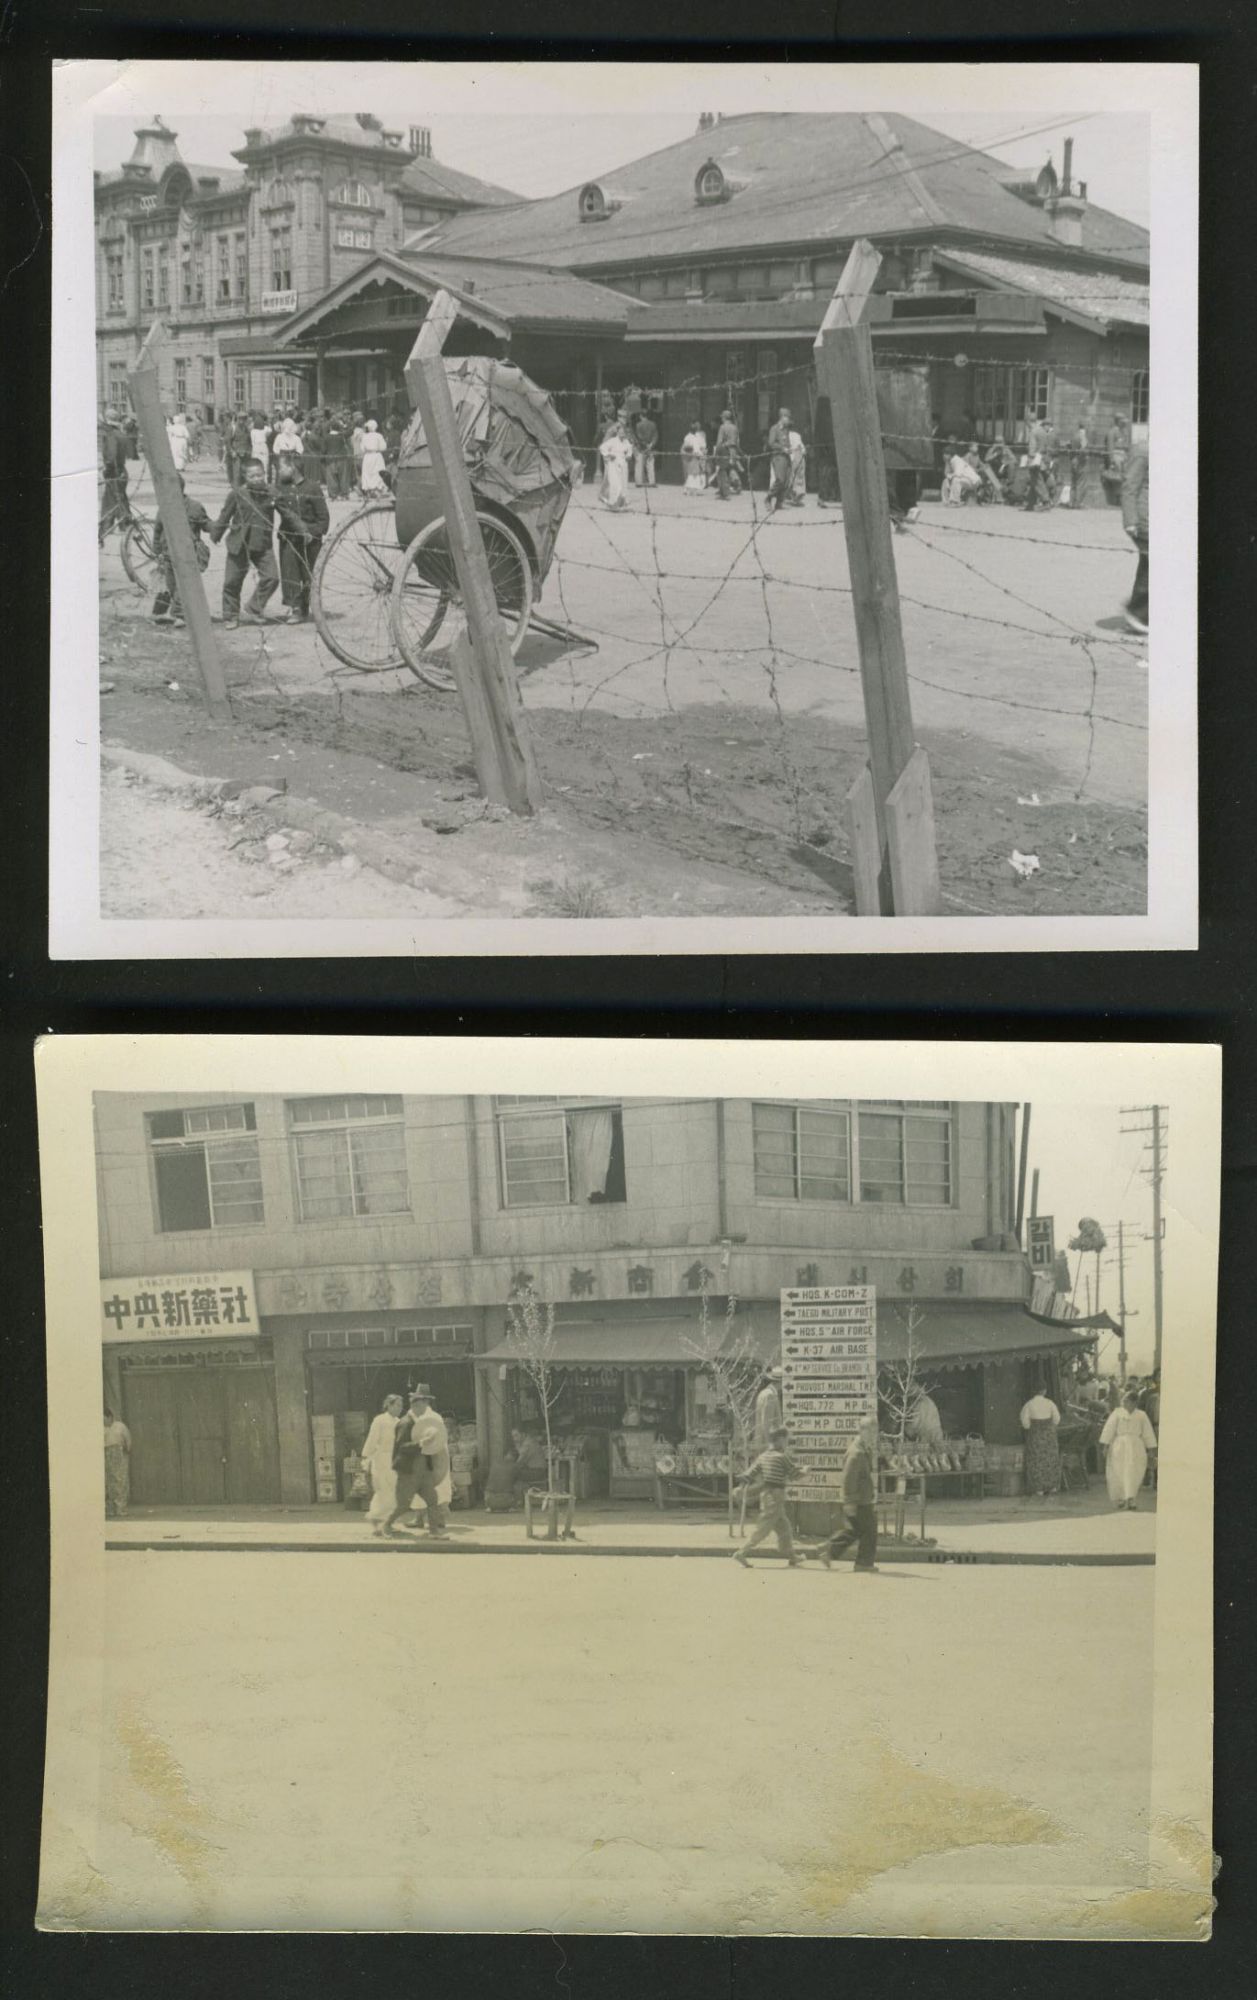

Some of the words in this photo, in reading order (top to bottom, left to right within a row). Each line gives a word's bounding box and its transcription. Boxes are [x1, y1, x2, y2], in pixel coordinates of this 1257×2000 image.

[1030, 1221, 1051, 1265] 갈비
[103, 1286, 251, 1330] 中央新藥社
[831, 1326, 845, 1335] AIR
[847, 1325, 873, 1335] FORCE
[830, 1344, 844, 1354] AIR
[847, 1344, 868, 1354] BASE
